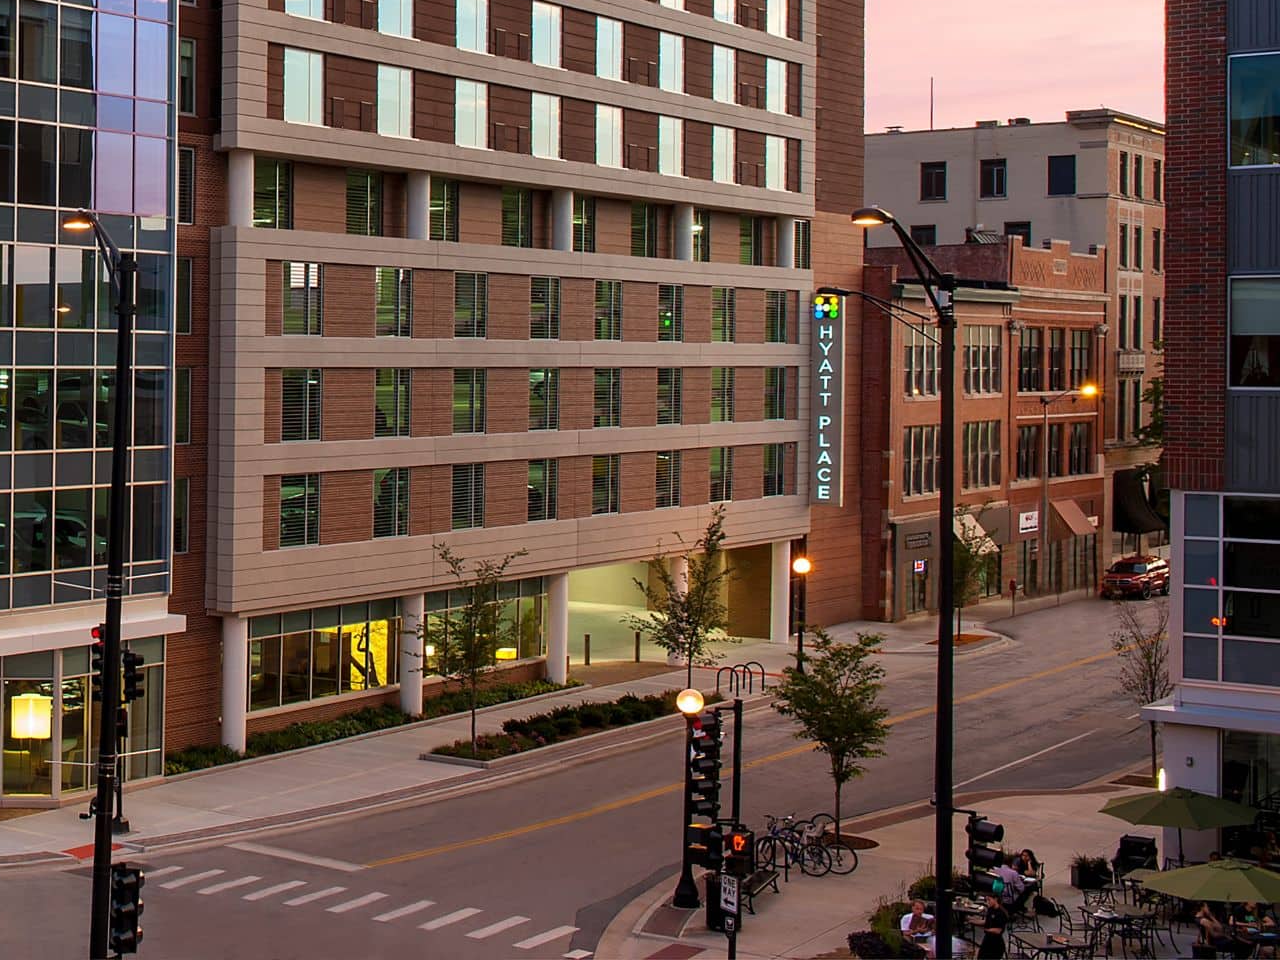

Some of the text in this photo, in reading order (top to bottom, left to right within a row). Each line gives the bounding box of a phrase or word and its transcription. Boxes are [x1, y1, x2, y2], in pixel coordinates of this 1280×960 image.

[816, 325, 834, 500] HYATT PLACE
[722, 875, 736, 888] ONE
[722, 886, 736, 897] WAY
